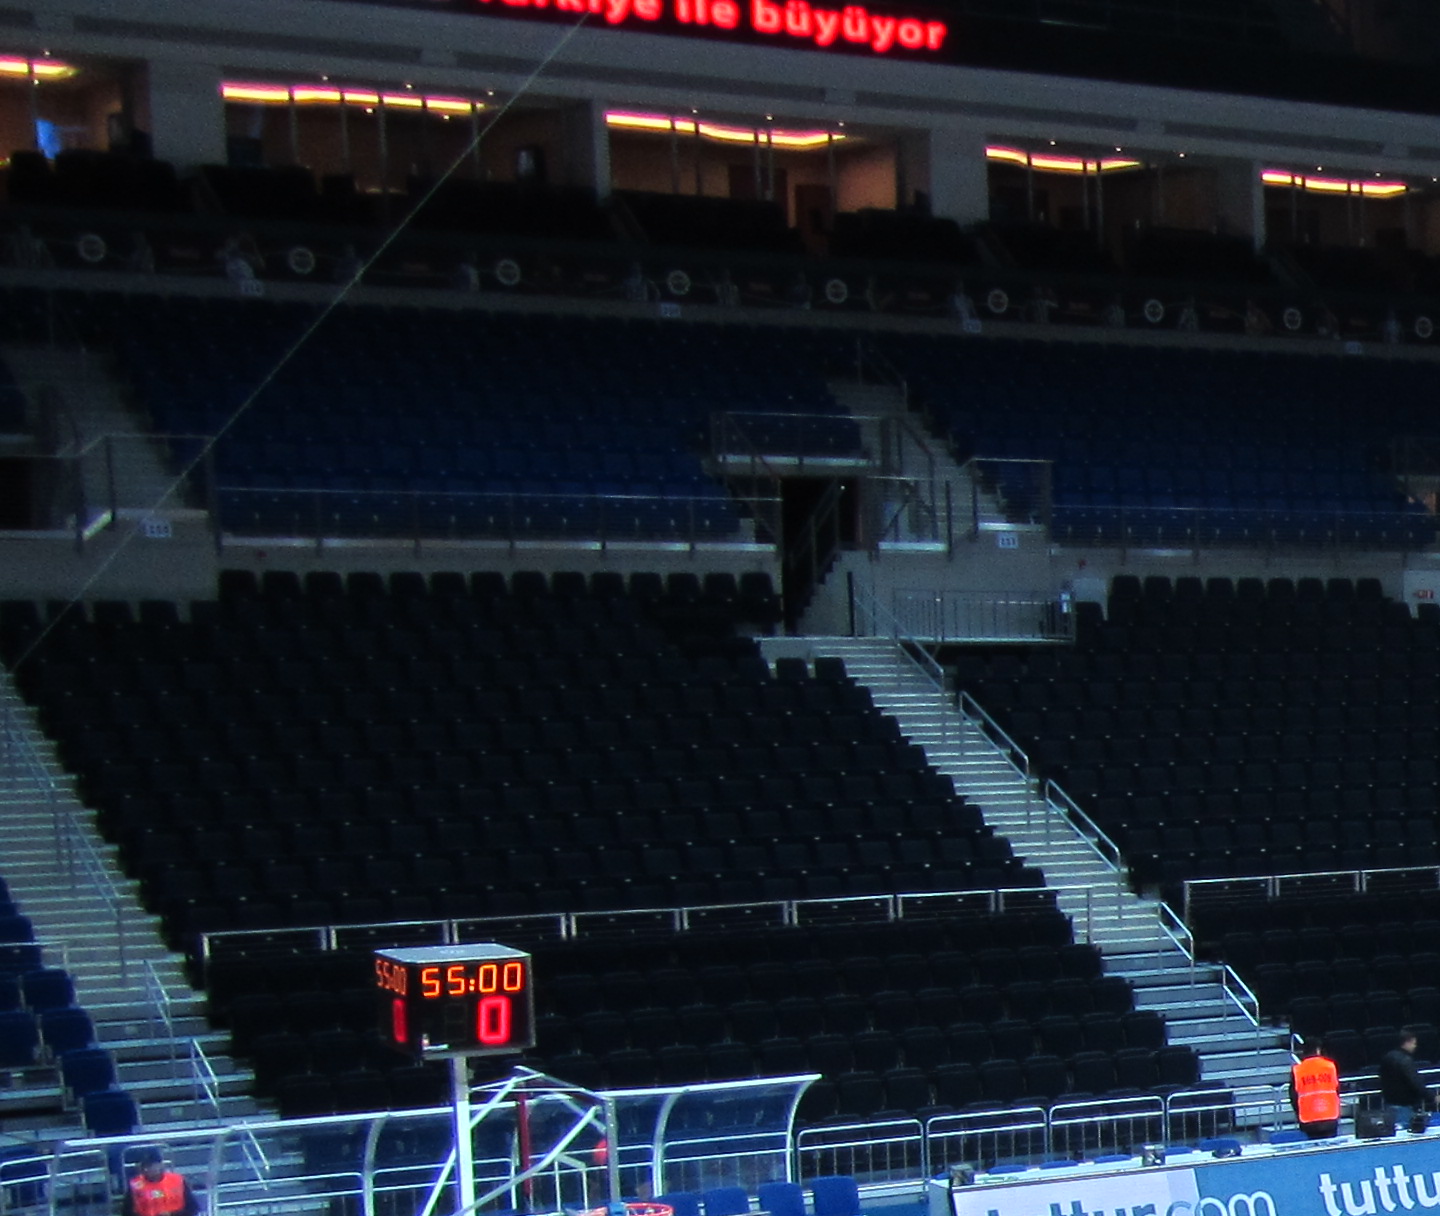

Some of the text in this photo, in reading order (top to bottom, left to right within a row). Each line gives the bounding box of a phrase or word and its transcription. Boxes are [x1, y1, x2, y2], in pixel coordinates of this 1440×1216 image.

[751, 0, 947, 52] büyüyor
[421, 962, 522, 998] 55:00
[478, 996, 511, 1044] 0
